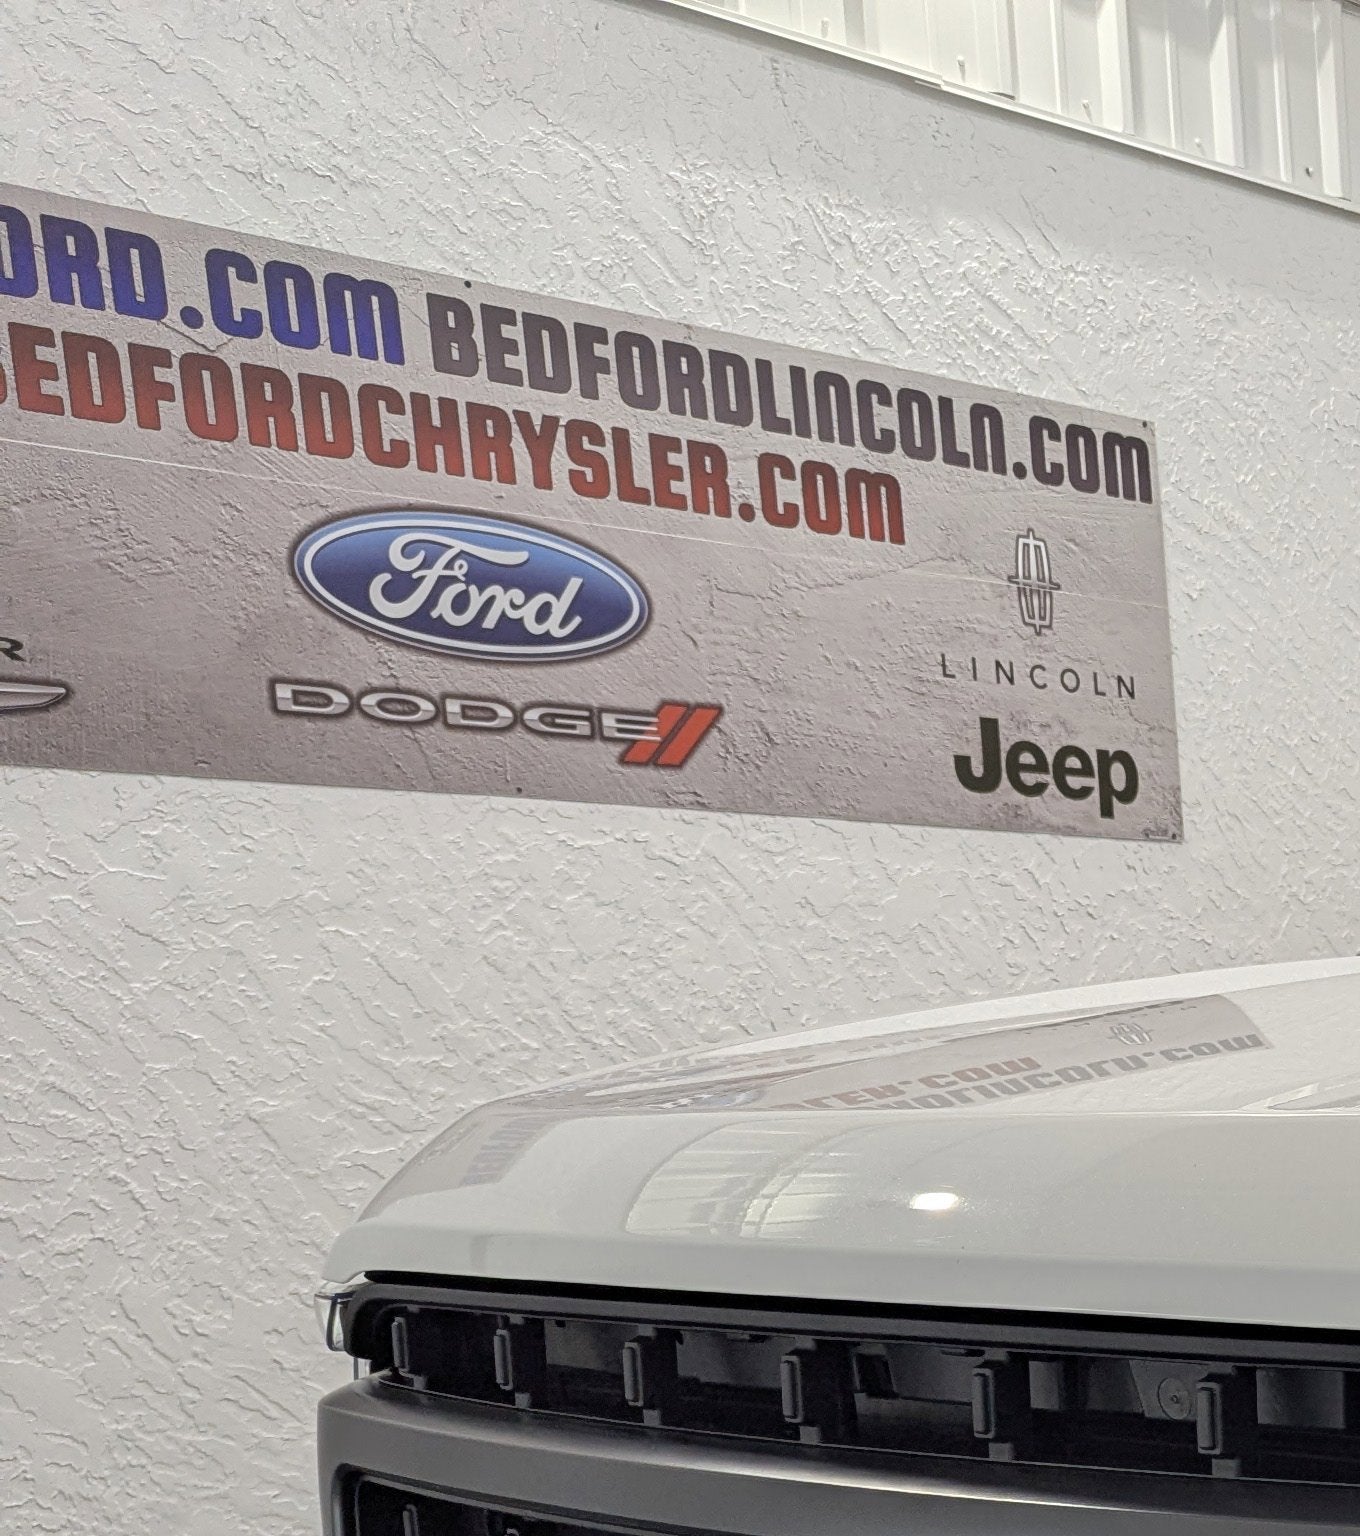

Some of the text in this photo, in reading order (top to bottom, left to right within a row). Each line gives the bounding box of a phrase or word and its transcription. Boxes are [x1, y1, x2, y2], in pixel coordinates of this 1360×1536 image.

[0, 321, 906, 546] EDFORDCHRYSLER.COM
[426, 293, 1153, 504] BEDFORDLINCOLN.COM
[369, 532, 583, 639] Ford
[273, 682, 662, 742] DODGE
[940, 653, 1136, 700] LINCOLN
[953, 716, 1139, 819] Jeep
